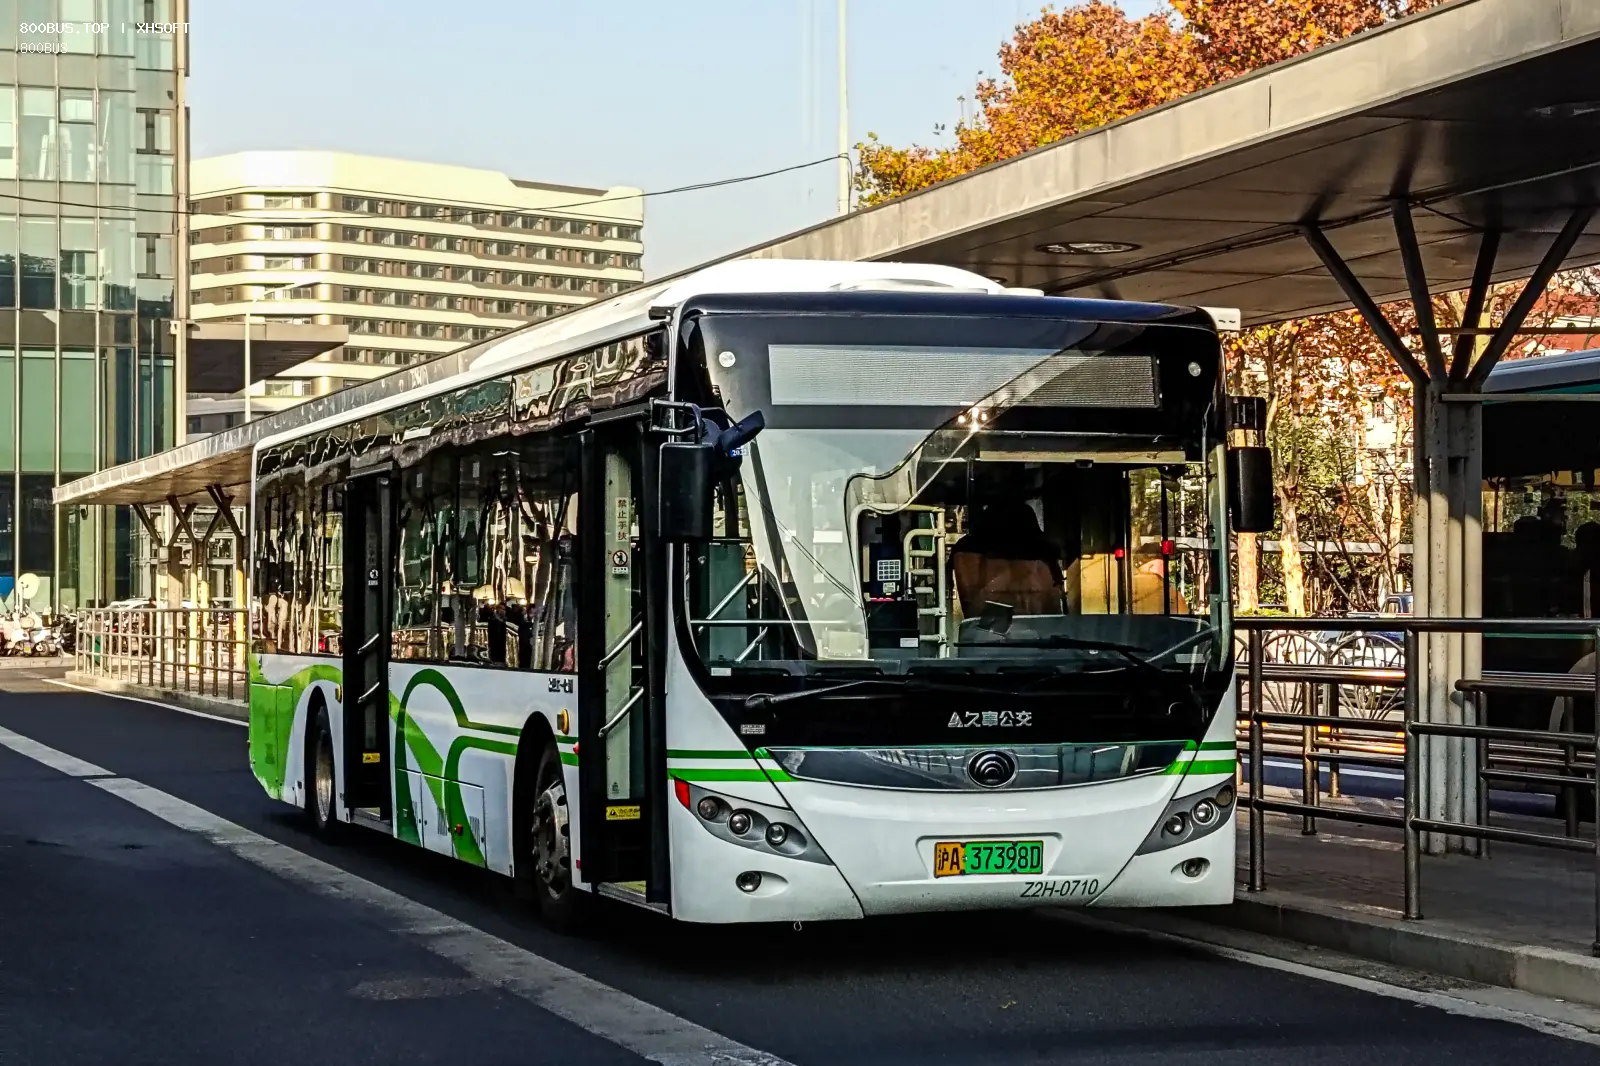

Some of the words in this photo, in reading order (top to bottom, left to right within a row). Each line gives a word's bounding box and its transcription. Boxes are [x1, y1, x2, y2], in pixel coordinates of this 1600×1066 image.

[617, 499, 627, 541] 禁止手扶
[963, 711, 1032, 728] 久事公交
[938, 848, 960, 871] 沪A
[970, 845, 1041, 870] 37398D
[1020, 879, 1099, 898] Z2H-0710
